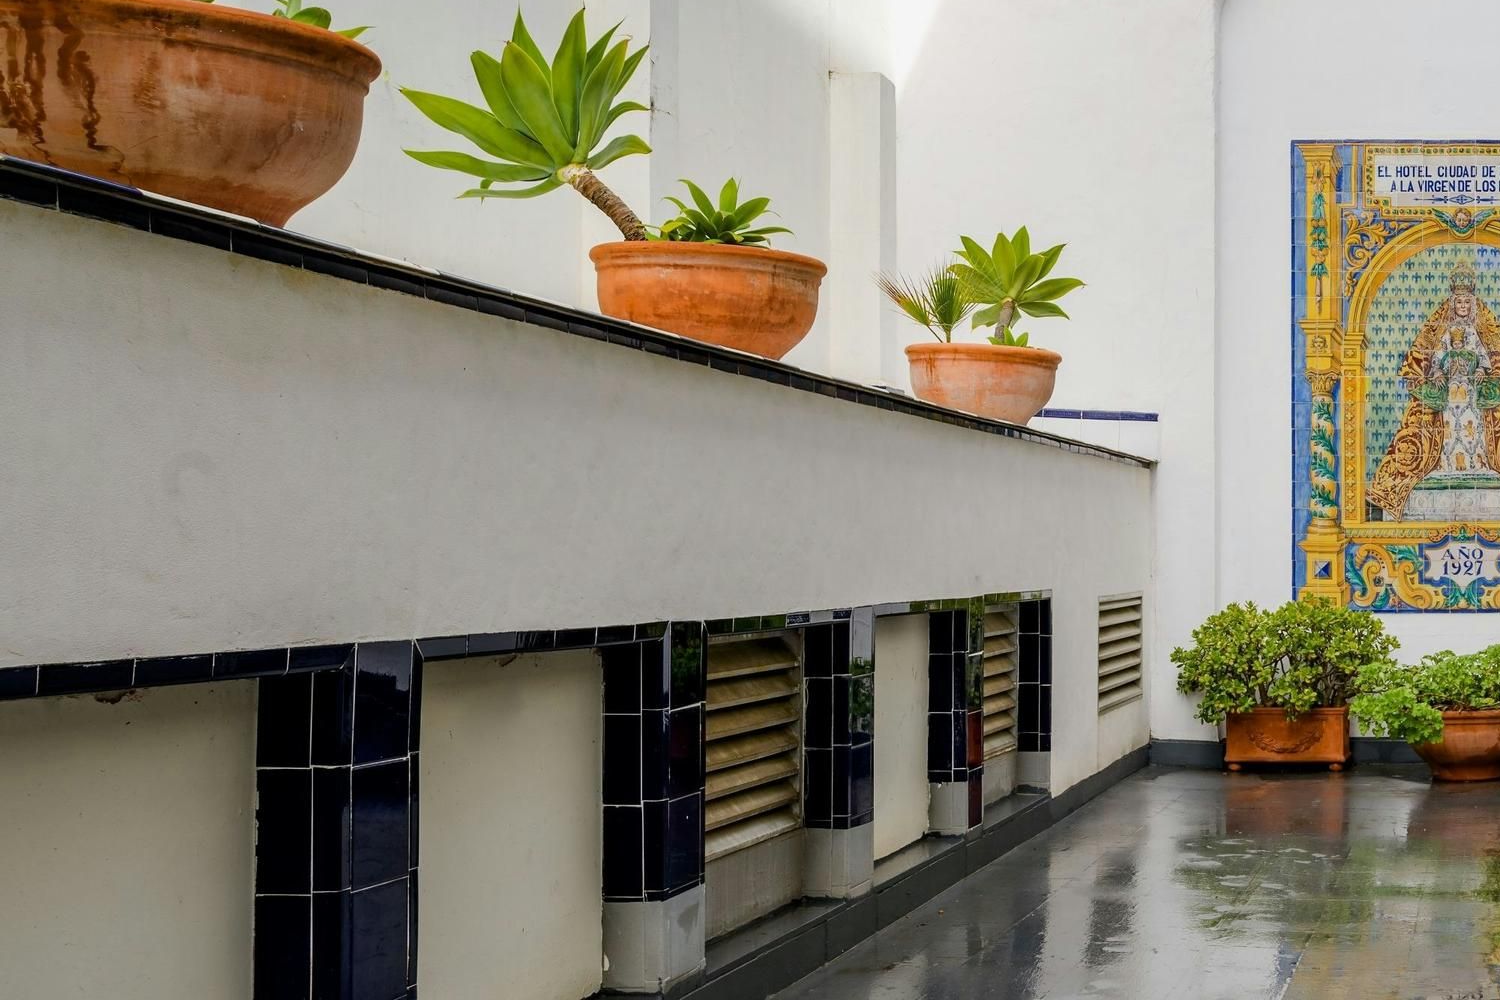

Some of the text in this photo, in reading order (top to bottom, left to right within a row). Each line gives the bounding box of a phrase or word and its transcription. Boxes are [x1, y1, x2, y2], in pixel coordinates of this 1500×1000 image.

[1377, 165, 1392, 178] EL
[1395, 165, 1432, 178] HOTEL
[1437, 165, 1478, 178] CIUDAD
[1482, 165, 1496, 178] DE
[1390, 180, 1398, 193] A
[1400, 180, 1414, 193] LA
[1417, 180, 1456, 193] VIRGEN
[1458, 180, 1472, 193] DE
[1475, 180, 1496, 193] LOS
[1441, 546, 1484, 560] AÑO
[1443, 560, 1483, 576] 1927
